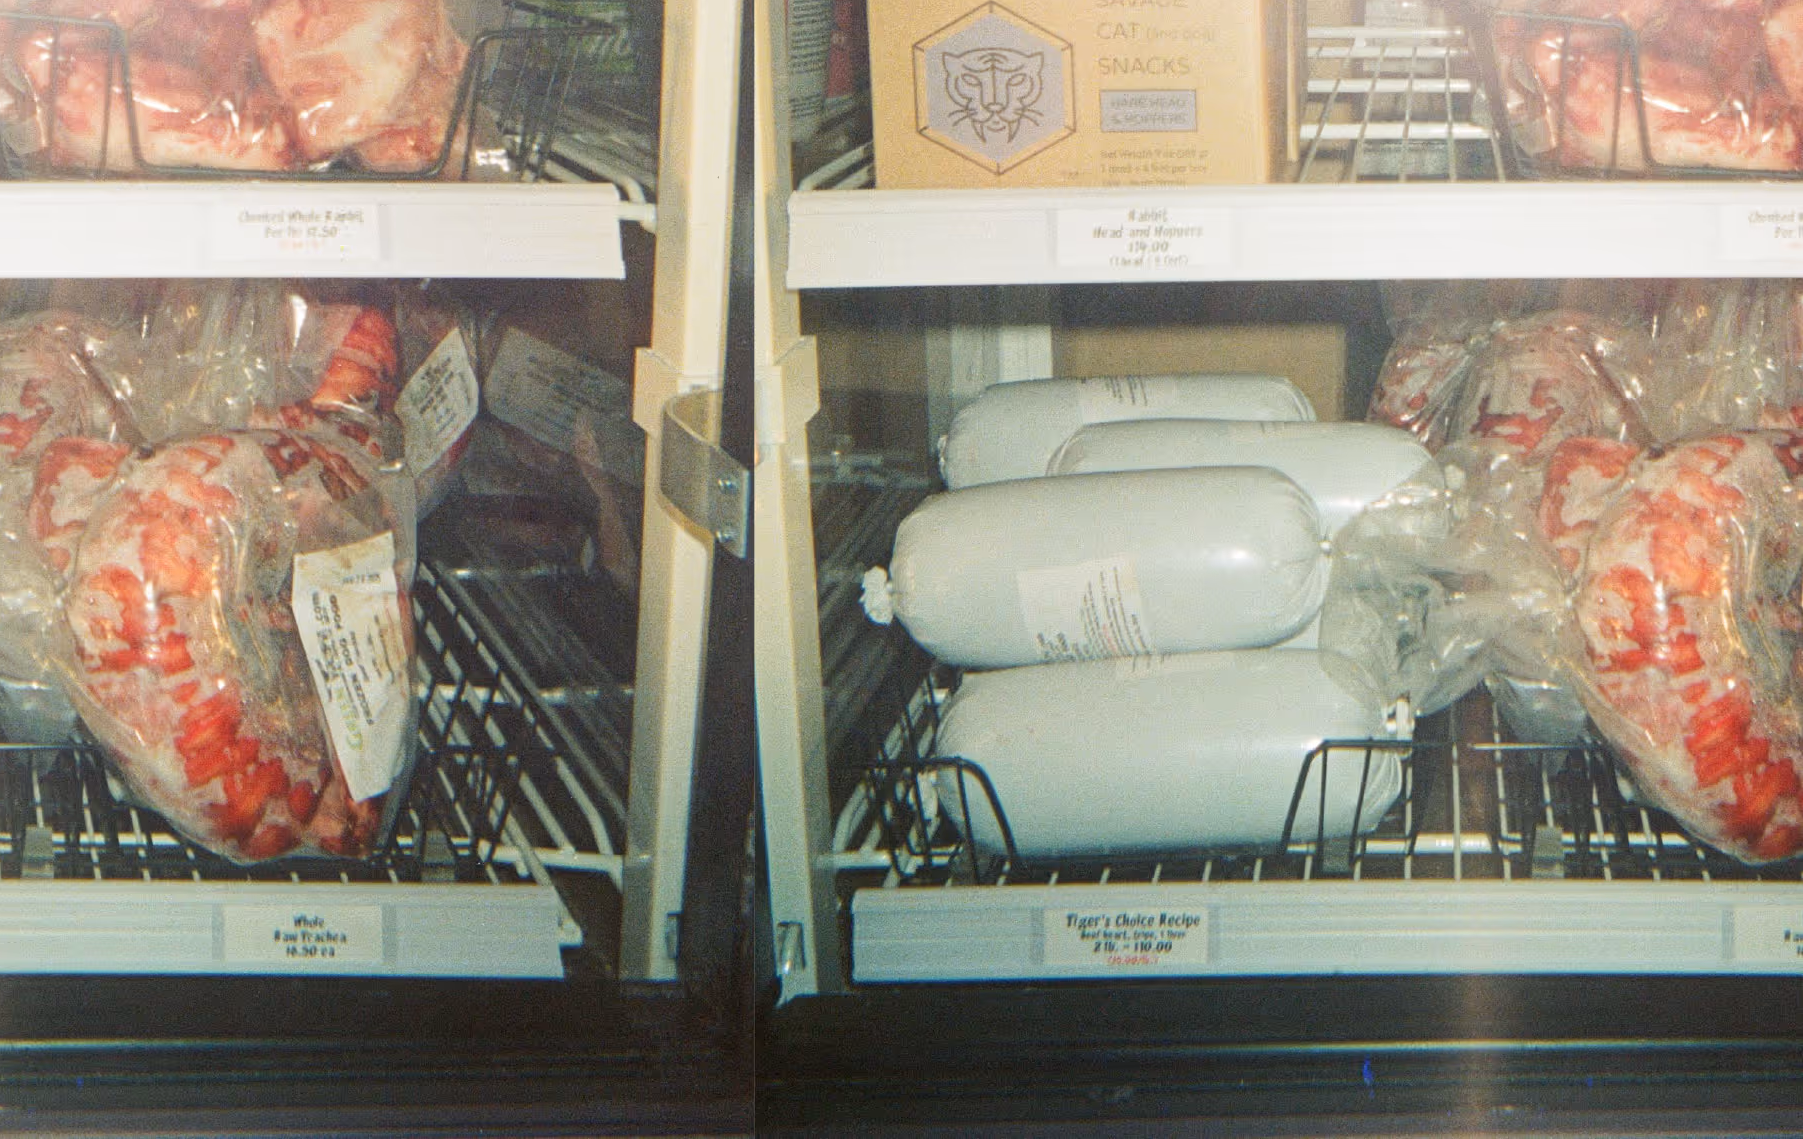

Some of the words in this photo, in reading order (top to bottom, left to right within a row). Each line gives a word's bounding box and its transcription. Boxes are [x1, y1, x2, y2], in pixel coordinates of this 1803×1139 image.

[1097, 22, 1140, 40] CAT
[1098, 56, 1195, 76] SNACKS
[1092, 224, 1123, 239] Head
[1129, 225, 1150, 239] and
[293, 913, 325, 928] Whole
[1066, 912, 1111, 931] Tiger's
[1115, 911, 1155, 928] Choice
[1159, 912, 1201, 929] Recipe
[273, 928, 298, 943] Raw
[1093, 941, 1101, 953] 2
